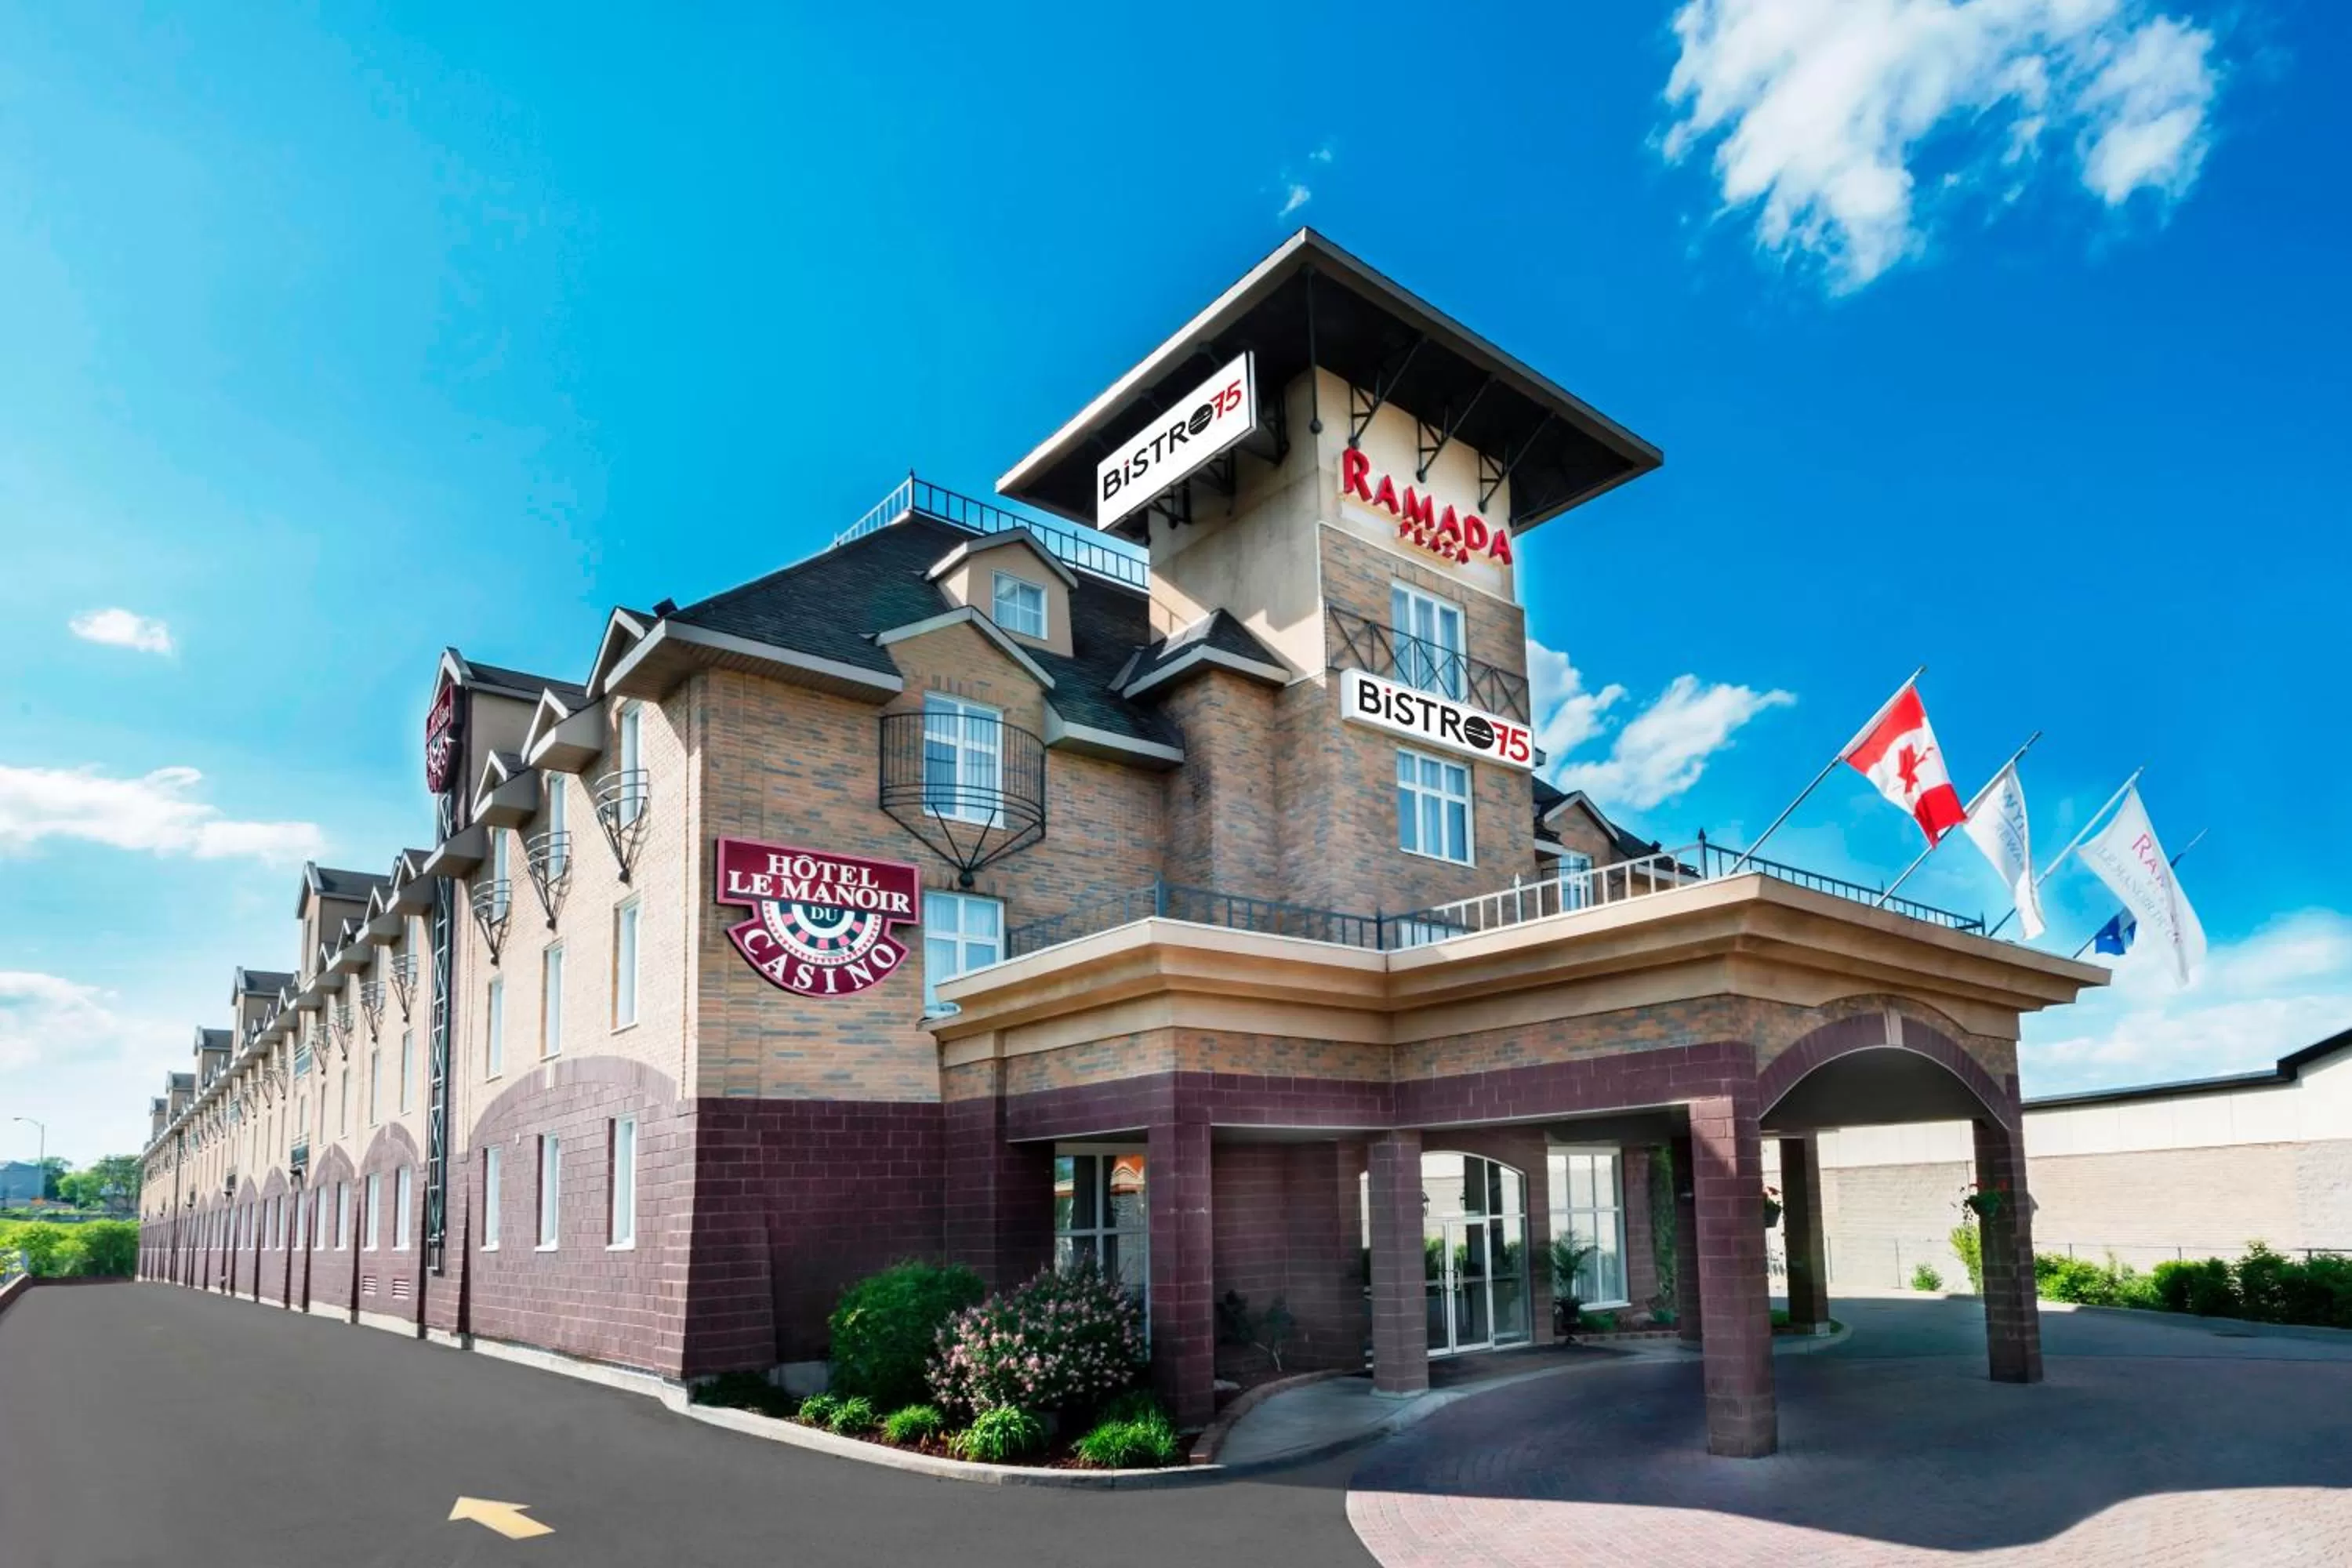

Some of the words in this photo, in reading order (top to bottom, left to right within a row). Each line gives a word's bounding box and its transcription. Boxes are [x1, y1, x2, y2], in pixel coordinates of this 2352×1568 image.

[1342, 446, 1512, 565] RAMADA
[1399, 519, 1469, 564] PLAZA
[728, 870, 772, 895] LE
[782, 878, 912, 913] MANOIR
[767, 854, 879, 889] HÔTEL
[810, 906, 838, 921] DU
[744, 928, 897, 993] CASINO
